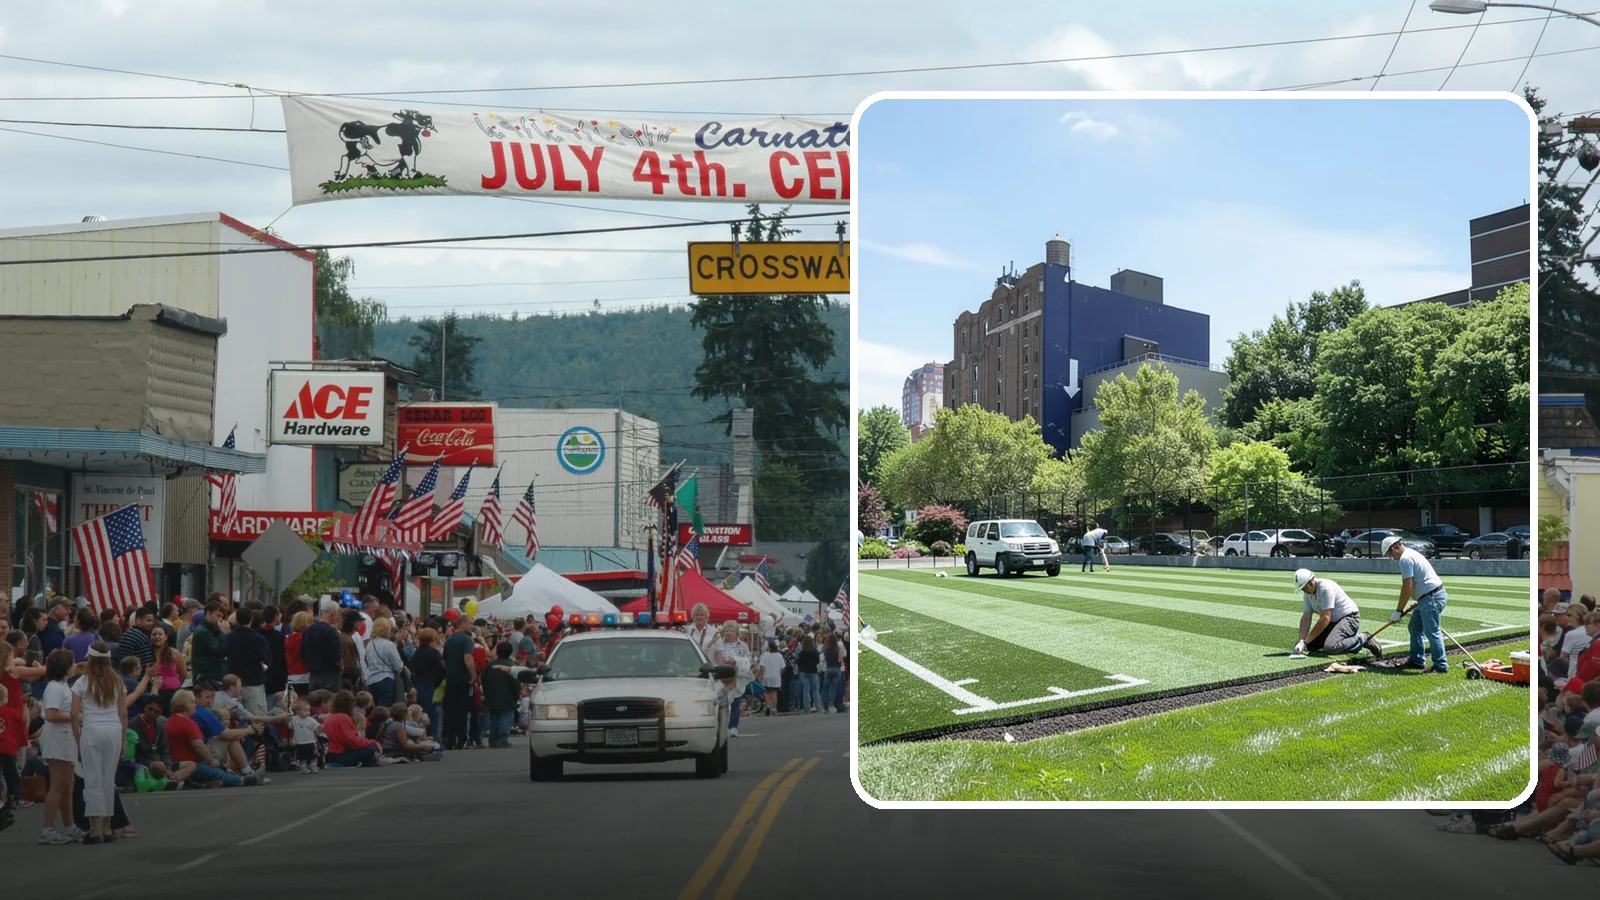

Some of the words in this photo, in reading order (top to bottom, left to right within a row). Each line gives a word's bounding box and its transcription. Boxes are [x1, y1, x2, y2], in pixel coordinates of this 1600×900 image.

[695, 122, 850, 150] Carnat
[481, 141, 605, 192] JULY
[632, 150, 746, 198] 4th.
[697, 254, 850, 280] CROSSWA
[282, 380, 373, 420] ACE
[405, 409, 452, 422] CEDAR
[460, 409, 486, 422] LOG
[283, 421, 371, 437] Hardware
[416, 427, 477, 447] Coca-Cola
[353, 467, 386, 480] Simpl
[95, 485, 124, 495] Vincent
[126, 486, 136, 495] de
[138, 486, 155, 496] Paul
[81, 503, 153, 522] THT
[688, 526, 741, 535] CRNATION
[699, 535, 730, 543] GLASS
